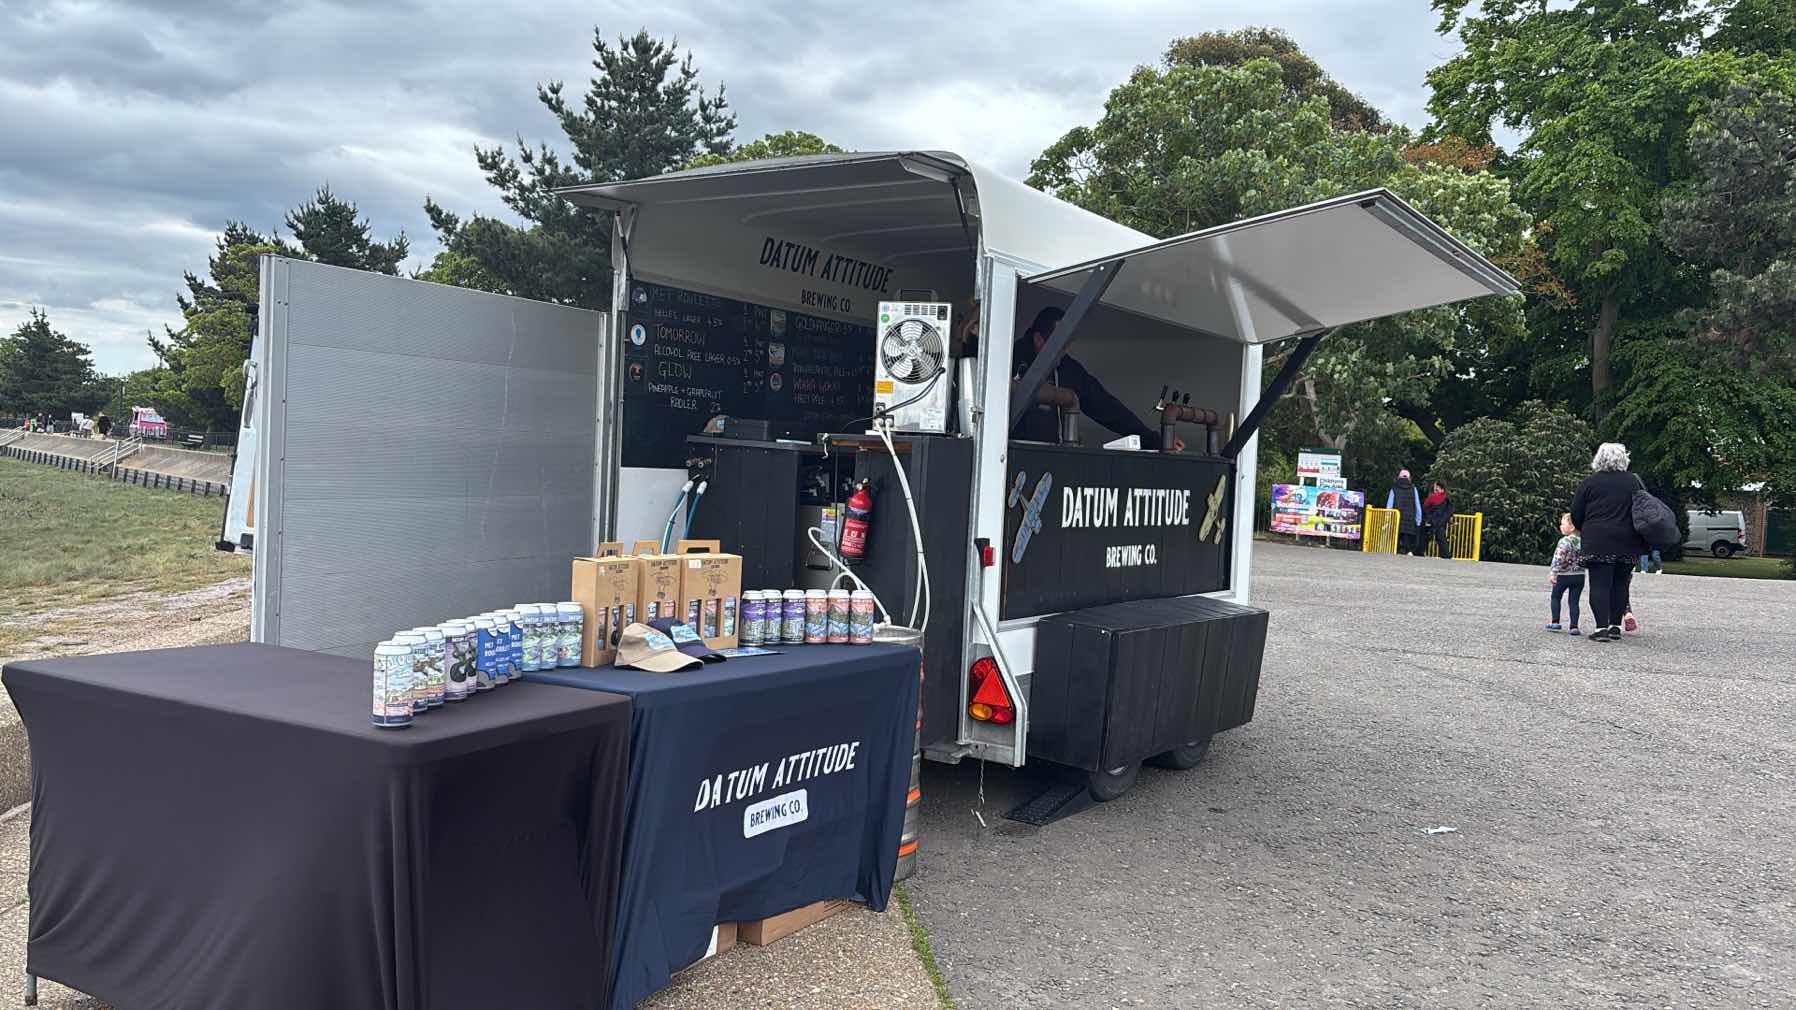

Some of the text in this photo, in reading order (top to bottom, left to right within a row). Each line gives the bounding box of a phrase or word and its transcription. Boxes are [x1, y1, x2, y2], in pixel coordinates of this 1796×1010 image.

[760, 237, 894, 293] DATUM ATTITUDE
[801, 289, 837, 311] BREWING
[656, 323, 706, 346] TOMORROW
[654, 344, 685, 358] ALCOHOL
[657, 360, 692, 380] GLOW
[648, 382, 680, 395] PINEAPPLE
[670, 396, 697, 409] RADLER
[1061, 487, 1191, 528] DATUM ATTITUDE
[1106, 544, 1157, 568] BREWING CO.
[694, 741, 860, 813] DATUM ATTITUDE
[750, 803, 787, 828] BREWING
